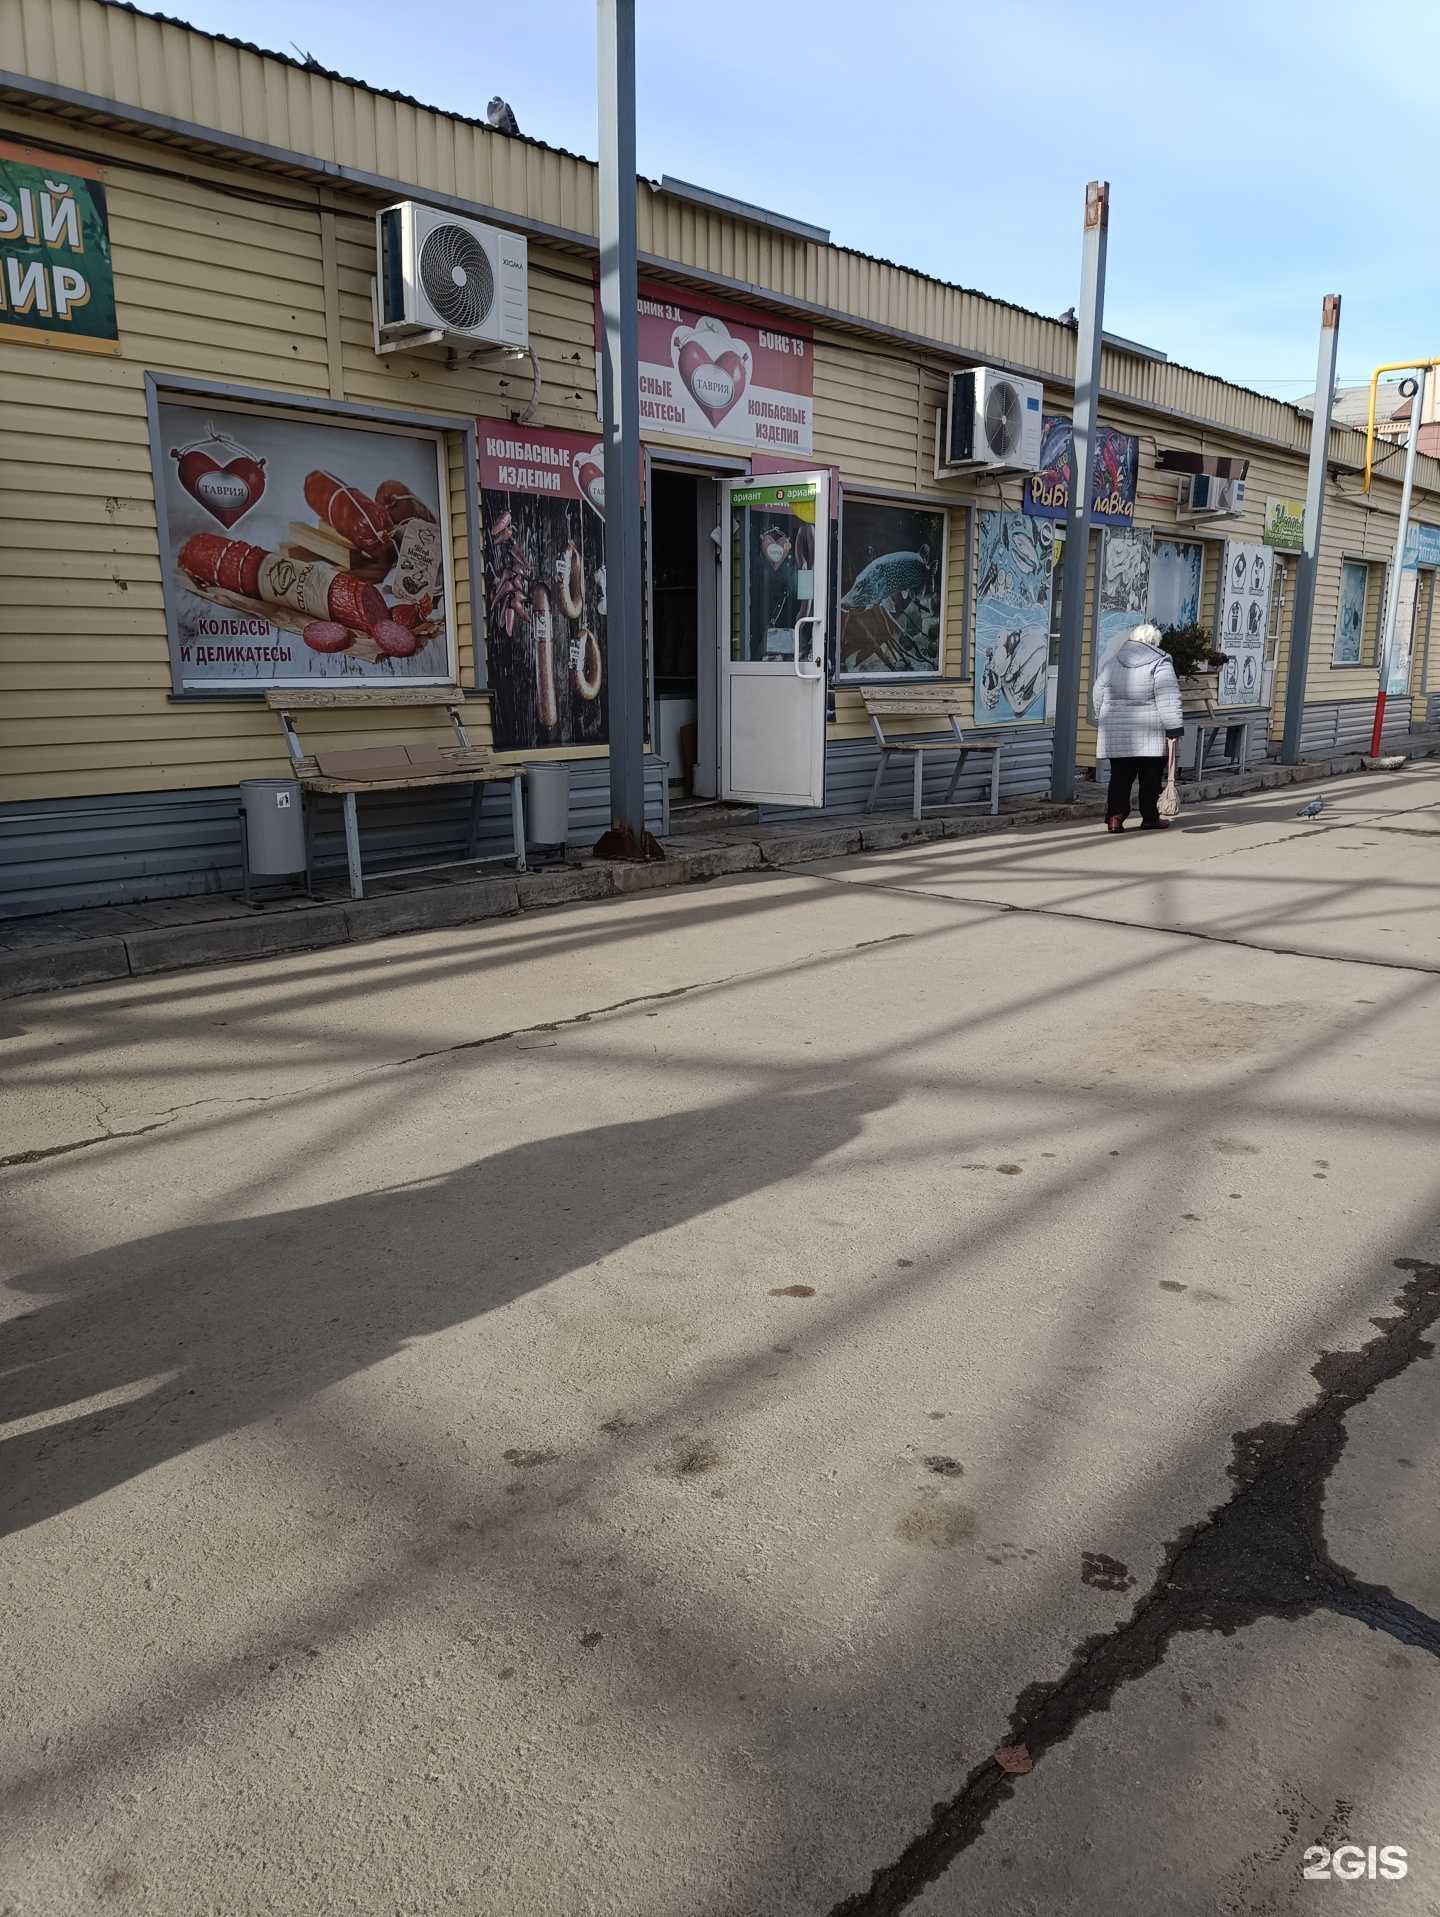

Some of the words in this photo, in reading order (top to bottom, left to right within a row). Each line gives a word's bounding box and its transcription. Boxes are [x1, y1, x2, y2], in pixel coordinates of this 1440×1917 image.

[0, 257, 88, 318] ИР
[759, 329, 791, 354] БОКС
[793, 338, 804, 356] 13
[639, 375, 673, 398] СНЫЕ
[697, 379, 729, 395] ТАВРИЯ
[640, 399, 686, 424] КАТЕСЫ
[748, 399, 806, 425] КОЛБАСНЫЕ
[755, 423, 799, 445] ИЗДЕЛИЯ
[486, 437, 570, 467] КОЛБАСНЫЕ
[498, 465, 560, 490] ИЗДЕЛИЯ
[202, 484, 245, 497] ТАВРИЯ
[733, 492, 762, 502] ариант
[199, 620, 270, 636] КОЛБАСЫ
[180, 647, 191, 662] И
[197, 646, 292, 666] ДЕЛИКАТЕСЫ
